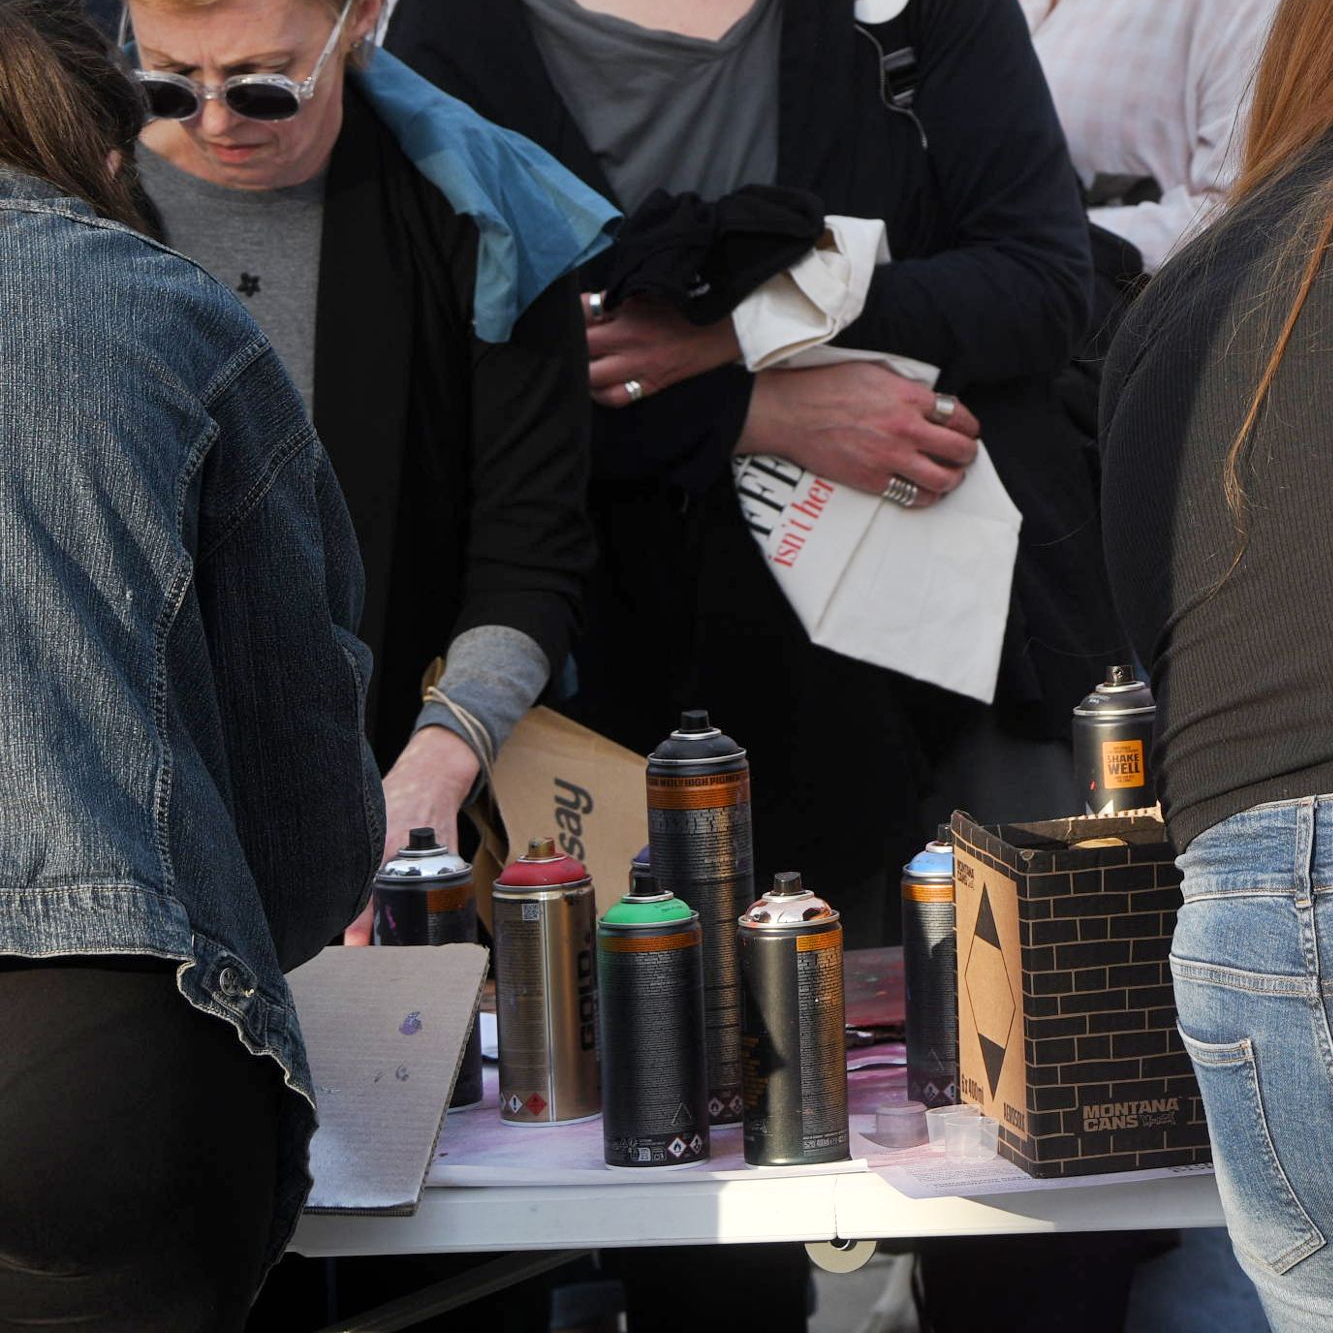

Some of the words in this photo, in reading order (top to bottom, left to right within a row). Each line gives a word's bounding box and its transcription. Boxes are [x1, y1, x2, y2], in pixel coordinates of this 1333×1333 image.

[1106, 752, 1140, 763] SHAKE
[1107, 761, 1140, 775] WELL
[1082, 1097, 1180, 1120] MONTANA
[1083, 1114, 1139, 1132] CANS
